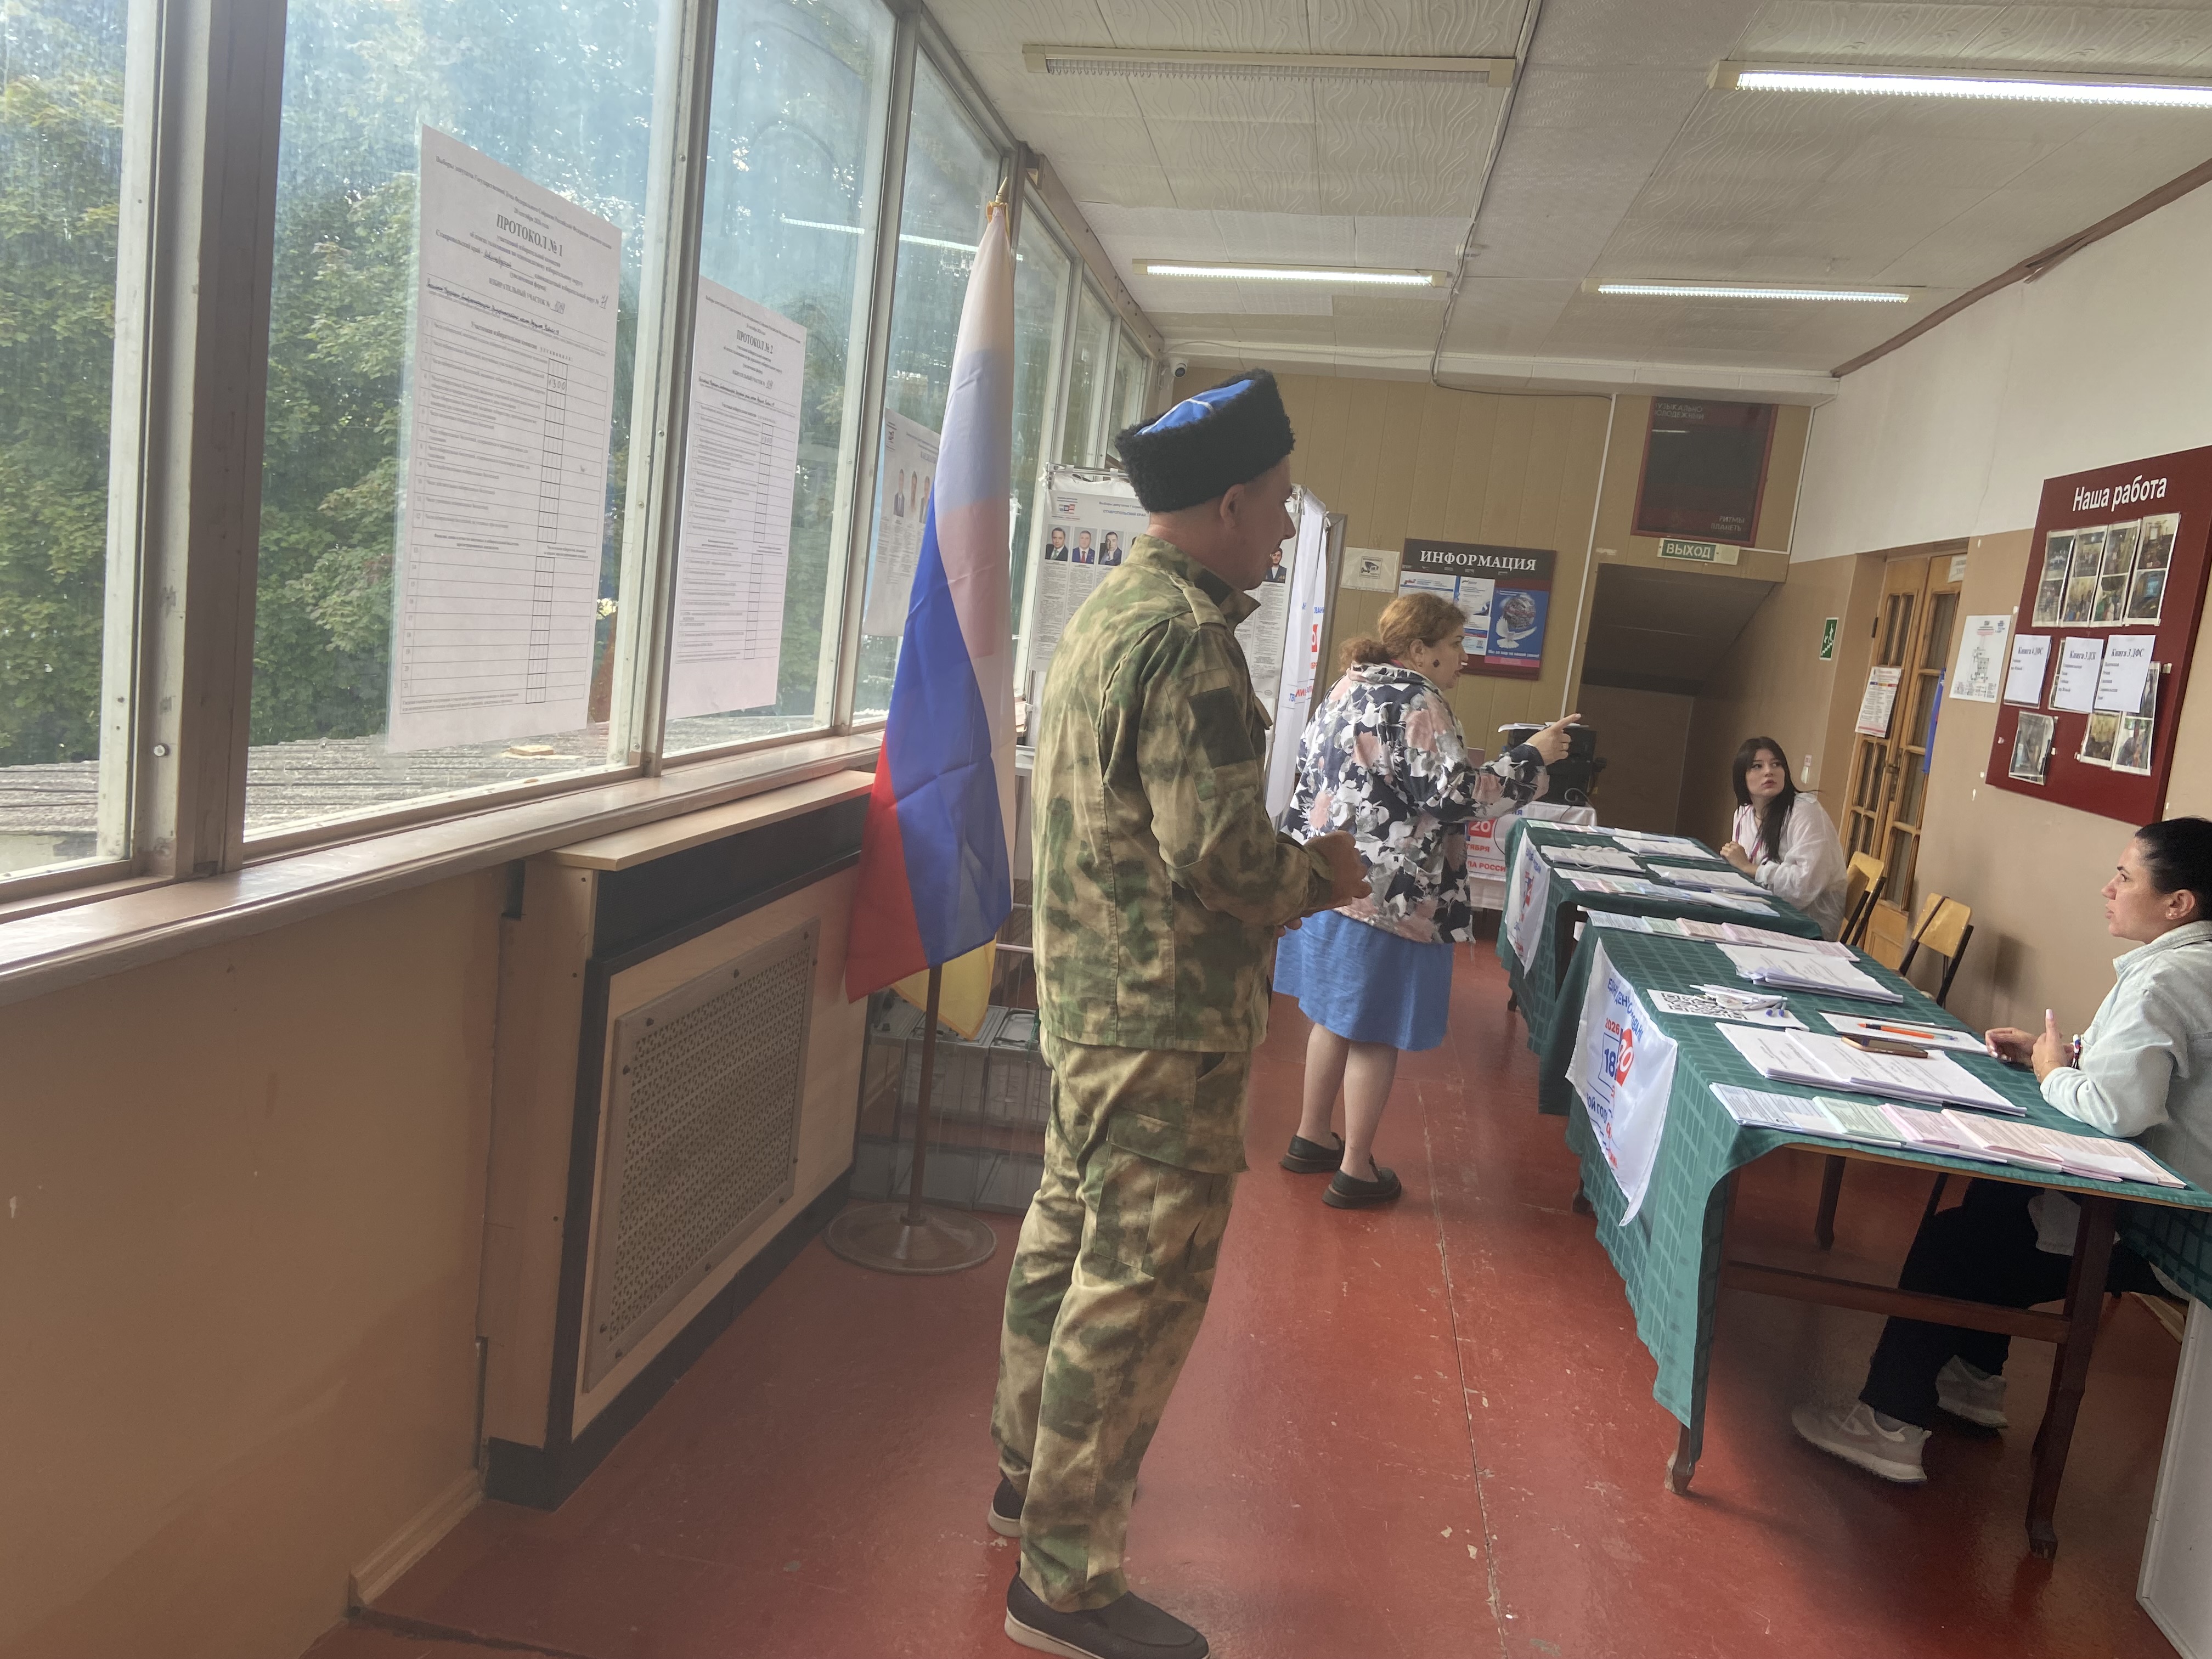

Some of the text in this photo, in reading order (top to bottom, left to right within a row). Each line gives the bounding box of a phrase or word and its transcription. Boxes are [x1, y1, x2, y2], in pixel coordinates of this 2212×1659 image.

[496, 214, 547, 249] ПРОТОКОЛ
[549, 239, 557, 253] №
[559, 245, 563, 257] 1
[737, 330, 764, 350] ПРОТОКОЛ
[770, 345, 773, 354] 2
[1656, 403, 1703, 413] УЗЫКАЛЬНО
[2073, 475, 2167, 512] Наша работа
[1666, 543, 1711, 559] ВЫХОД
[1420, 550, 1537, 572] ИНФОРМАЦИЯ
[2069, 651, 2084, 659] Книга
[2111, 648, 2145, 658] Книга 3 ДФС
[1470, 821, 1491, 833] 20
[1466, 843, 1490, 853] ТЯБРЯ
[1479, 862, 1506, 872] РОССИ
[1604, 1048, 1616, 1077] 18
[1616, 1039, 1634, 1073] 20
